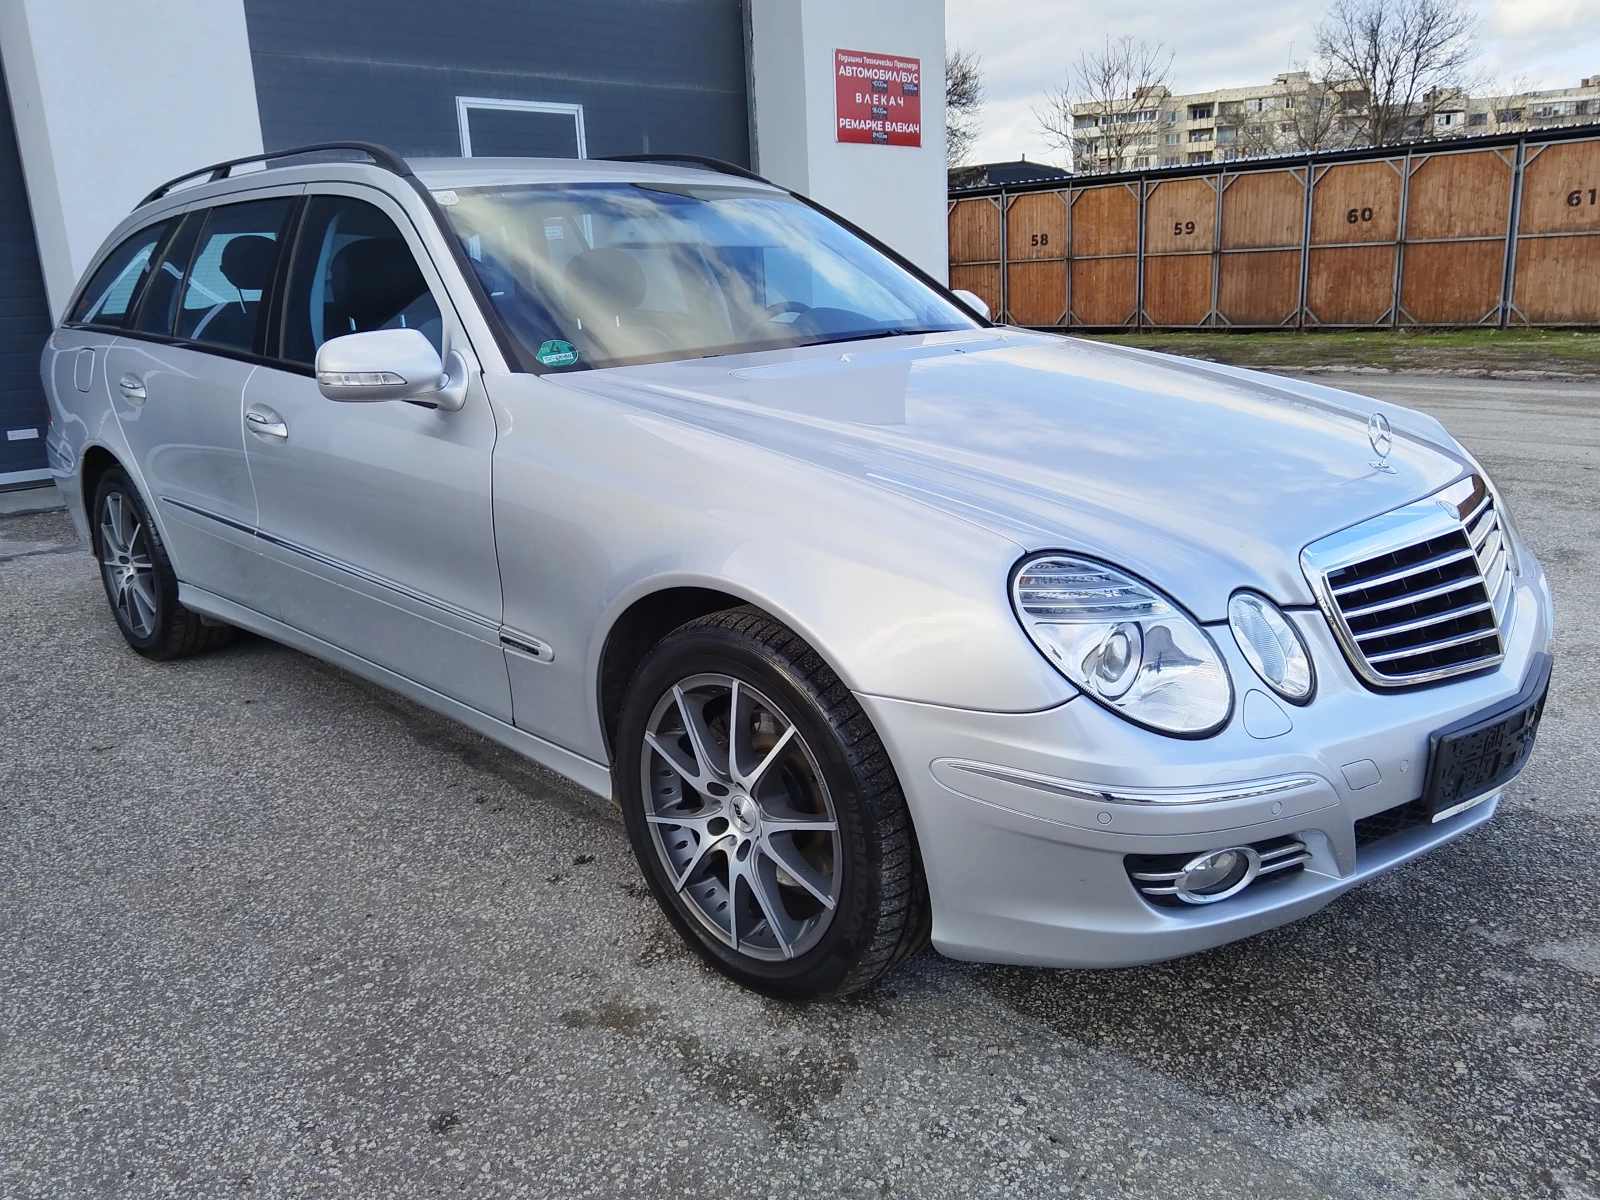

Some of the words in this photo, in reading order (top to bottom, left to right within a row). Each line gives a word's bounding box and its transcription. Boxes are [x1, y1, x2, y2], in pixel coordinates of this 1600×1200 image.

[838, 54, 862, 63] Годишни
[863, 57, 893, 66] Технически
[894, 60, 918, 71] Прегледи
[839, 66, 918, 83] АВТОМОБИЛ/БУС
[856, 93, 903, 107] ВЛЕКАЧ
[839, 117, 883, 131] РЕМАРКЕ
[885, 122, 919, 133] ВЛЕКАЧ
[1567, 188, 1597, 207] 61
[1346, 207, 1373, 224] 60
[1174, 221, 1195, 236] 59
[1031, 233, 1048, 247] 58
[550, 342, 561, 353] 4
